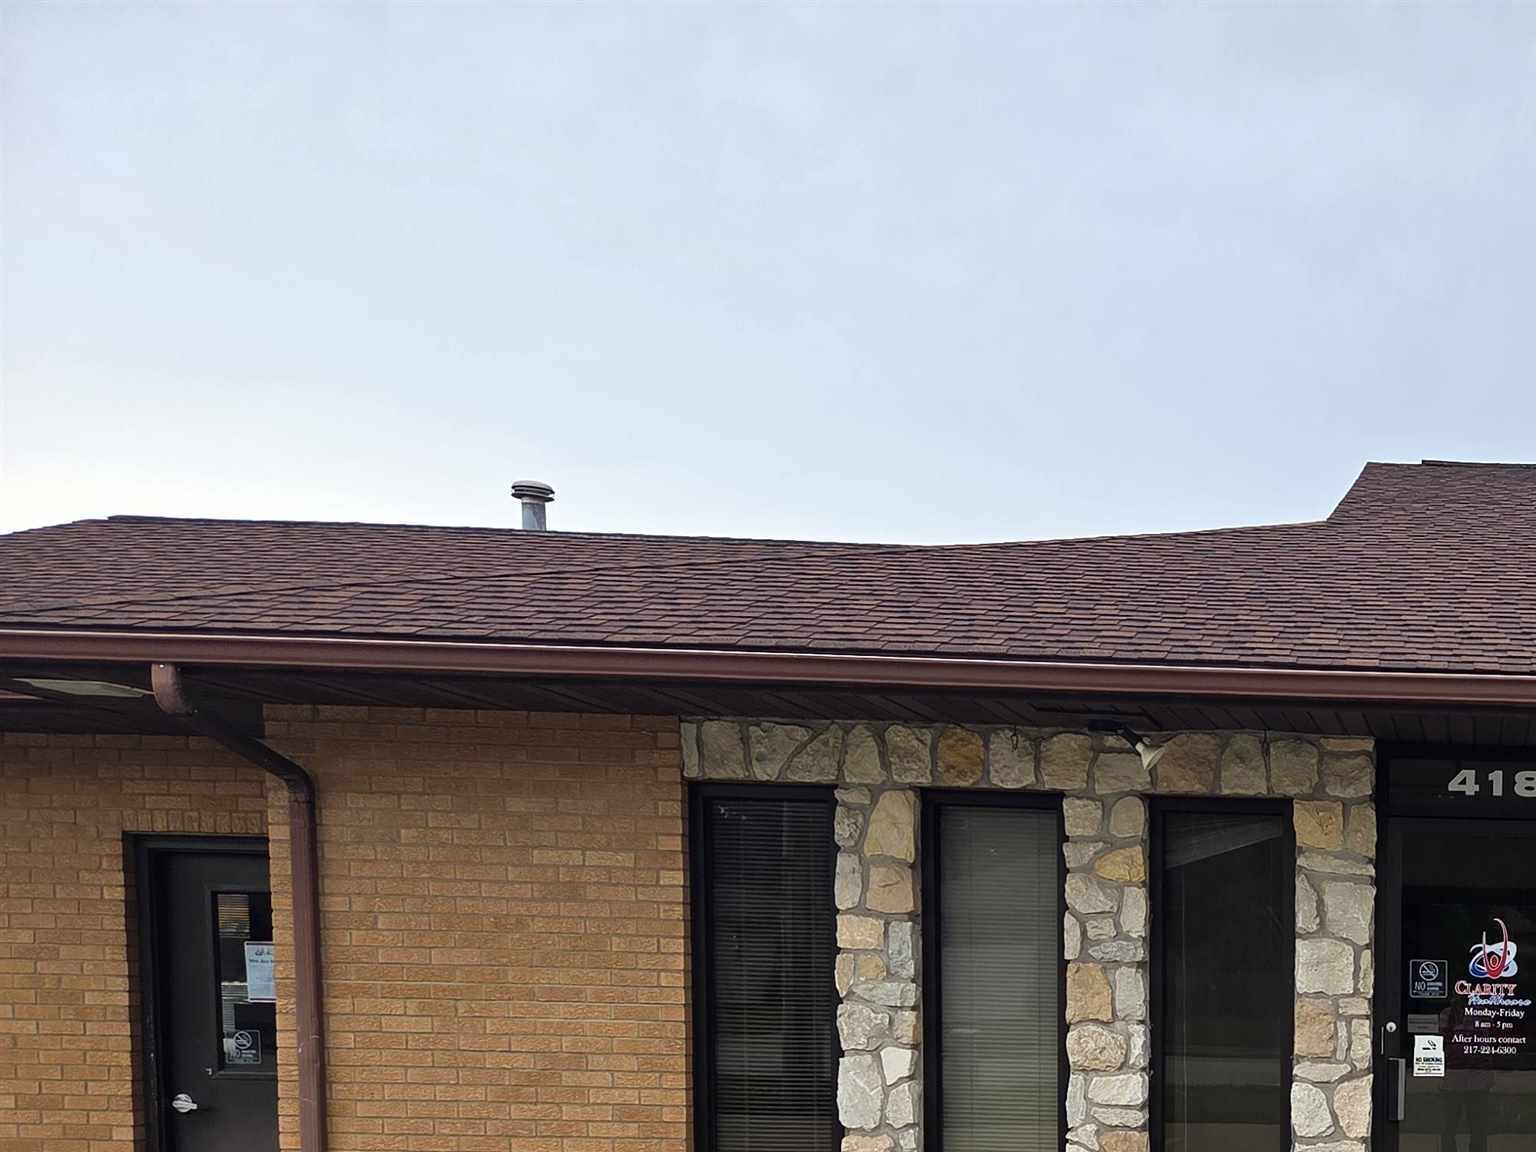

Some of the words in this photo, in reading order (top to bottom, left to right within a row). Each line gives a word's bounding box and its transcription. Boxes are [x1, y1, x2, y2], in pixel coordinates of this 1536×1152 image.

[1455, 980, 1517, 996] CLARITY
[1464, 1007, 1525, 1019] Monday-Friday
[1452, 1033, 1472, 1043] After
[1474, 1034, 1497, 1043] hours
